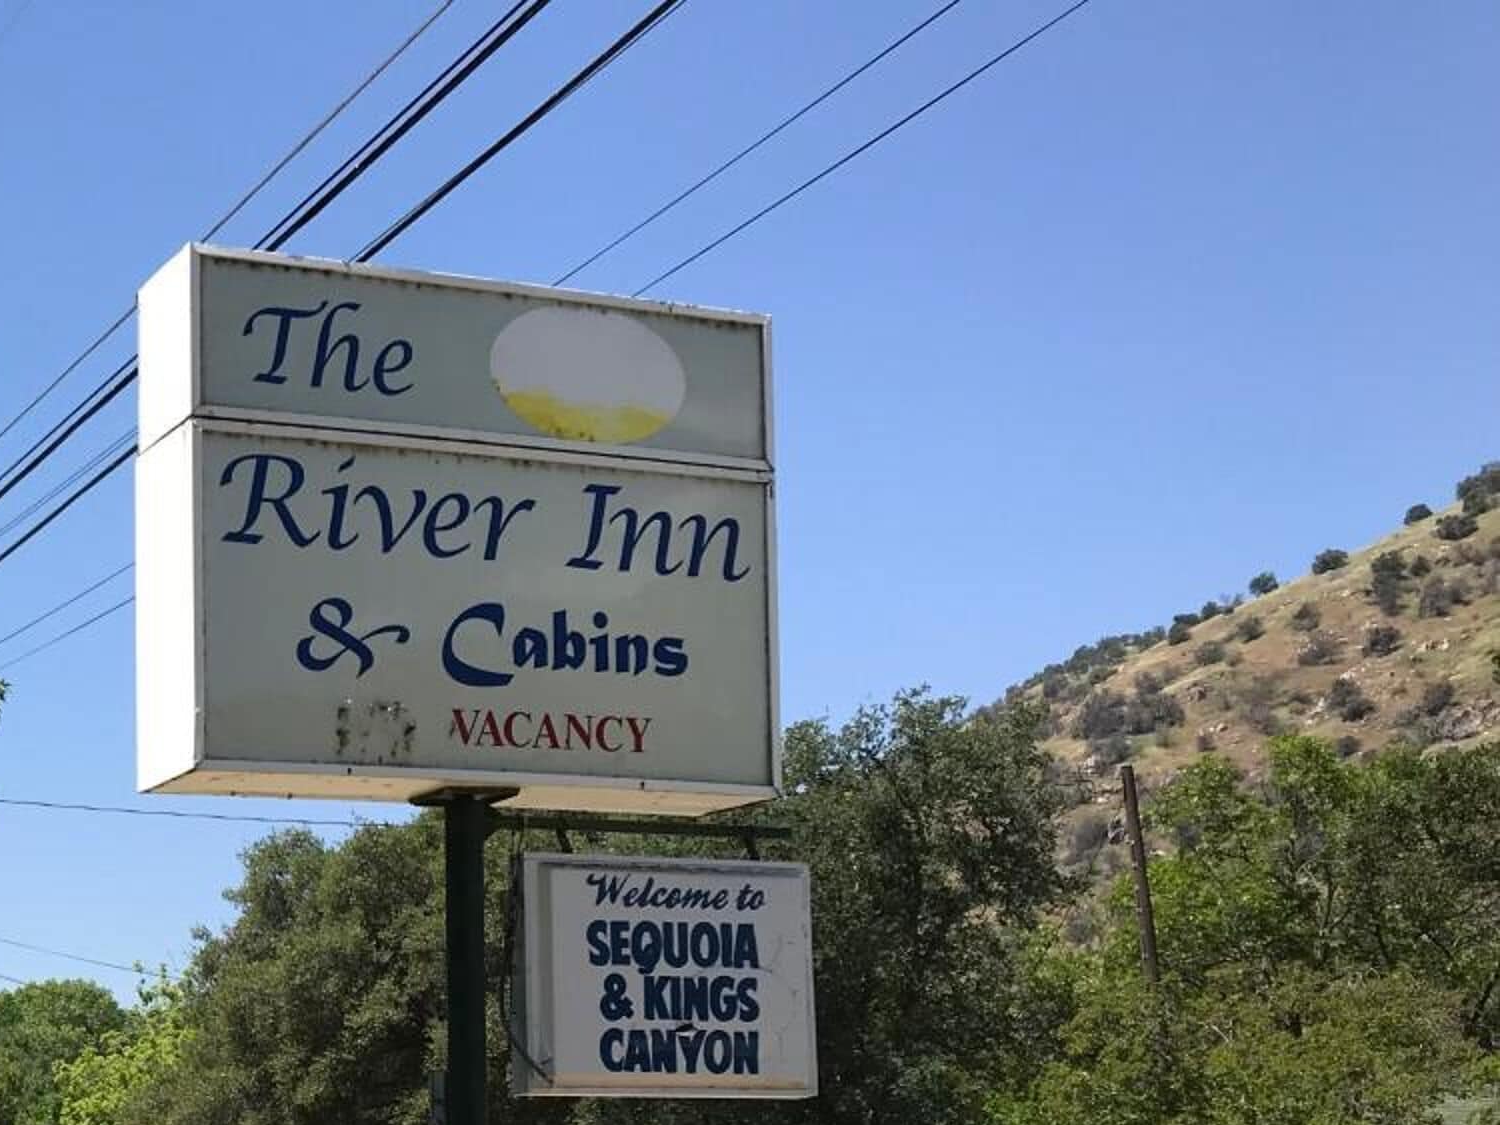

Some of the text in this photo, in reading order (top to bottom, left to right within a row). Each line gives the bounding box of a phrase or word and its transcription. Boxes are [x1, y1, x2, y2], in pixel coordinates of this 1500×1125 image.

[242, 300, 413, 395] The
[219, 453, 750, 581] River Inn
[296, 597, 688, 687] & Cabins
[451, 707, 652, 753] VACANCY
[587, 873, 766, 911] Welcome to
[586, 920, 759, 973] SEQUOIA
[600, 973, 759, 1022] & KINGS
[600, 1028, 758, 1074] CANYON
